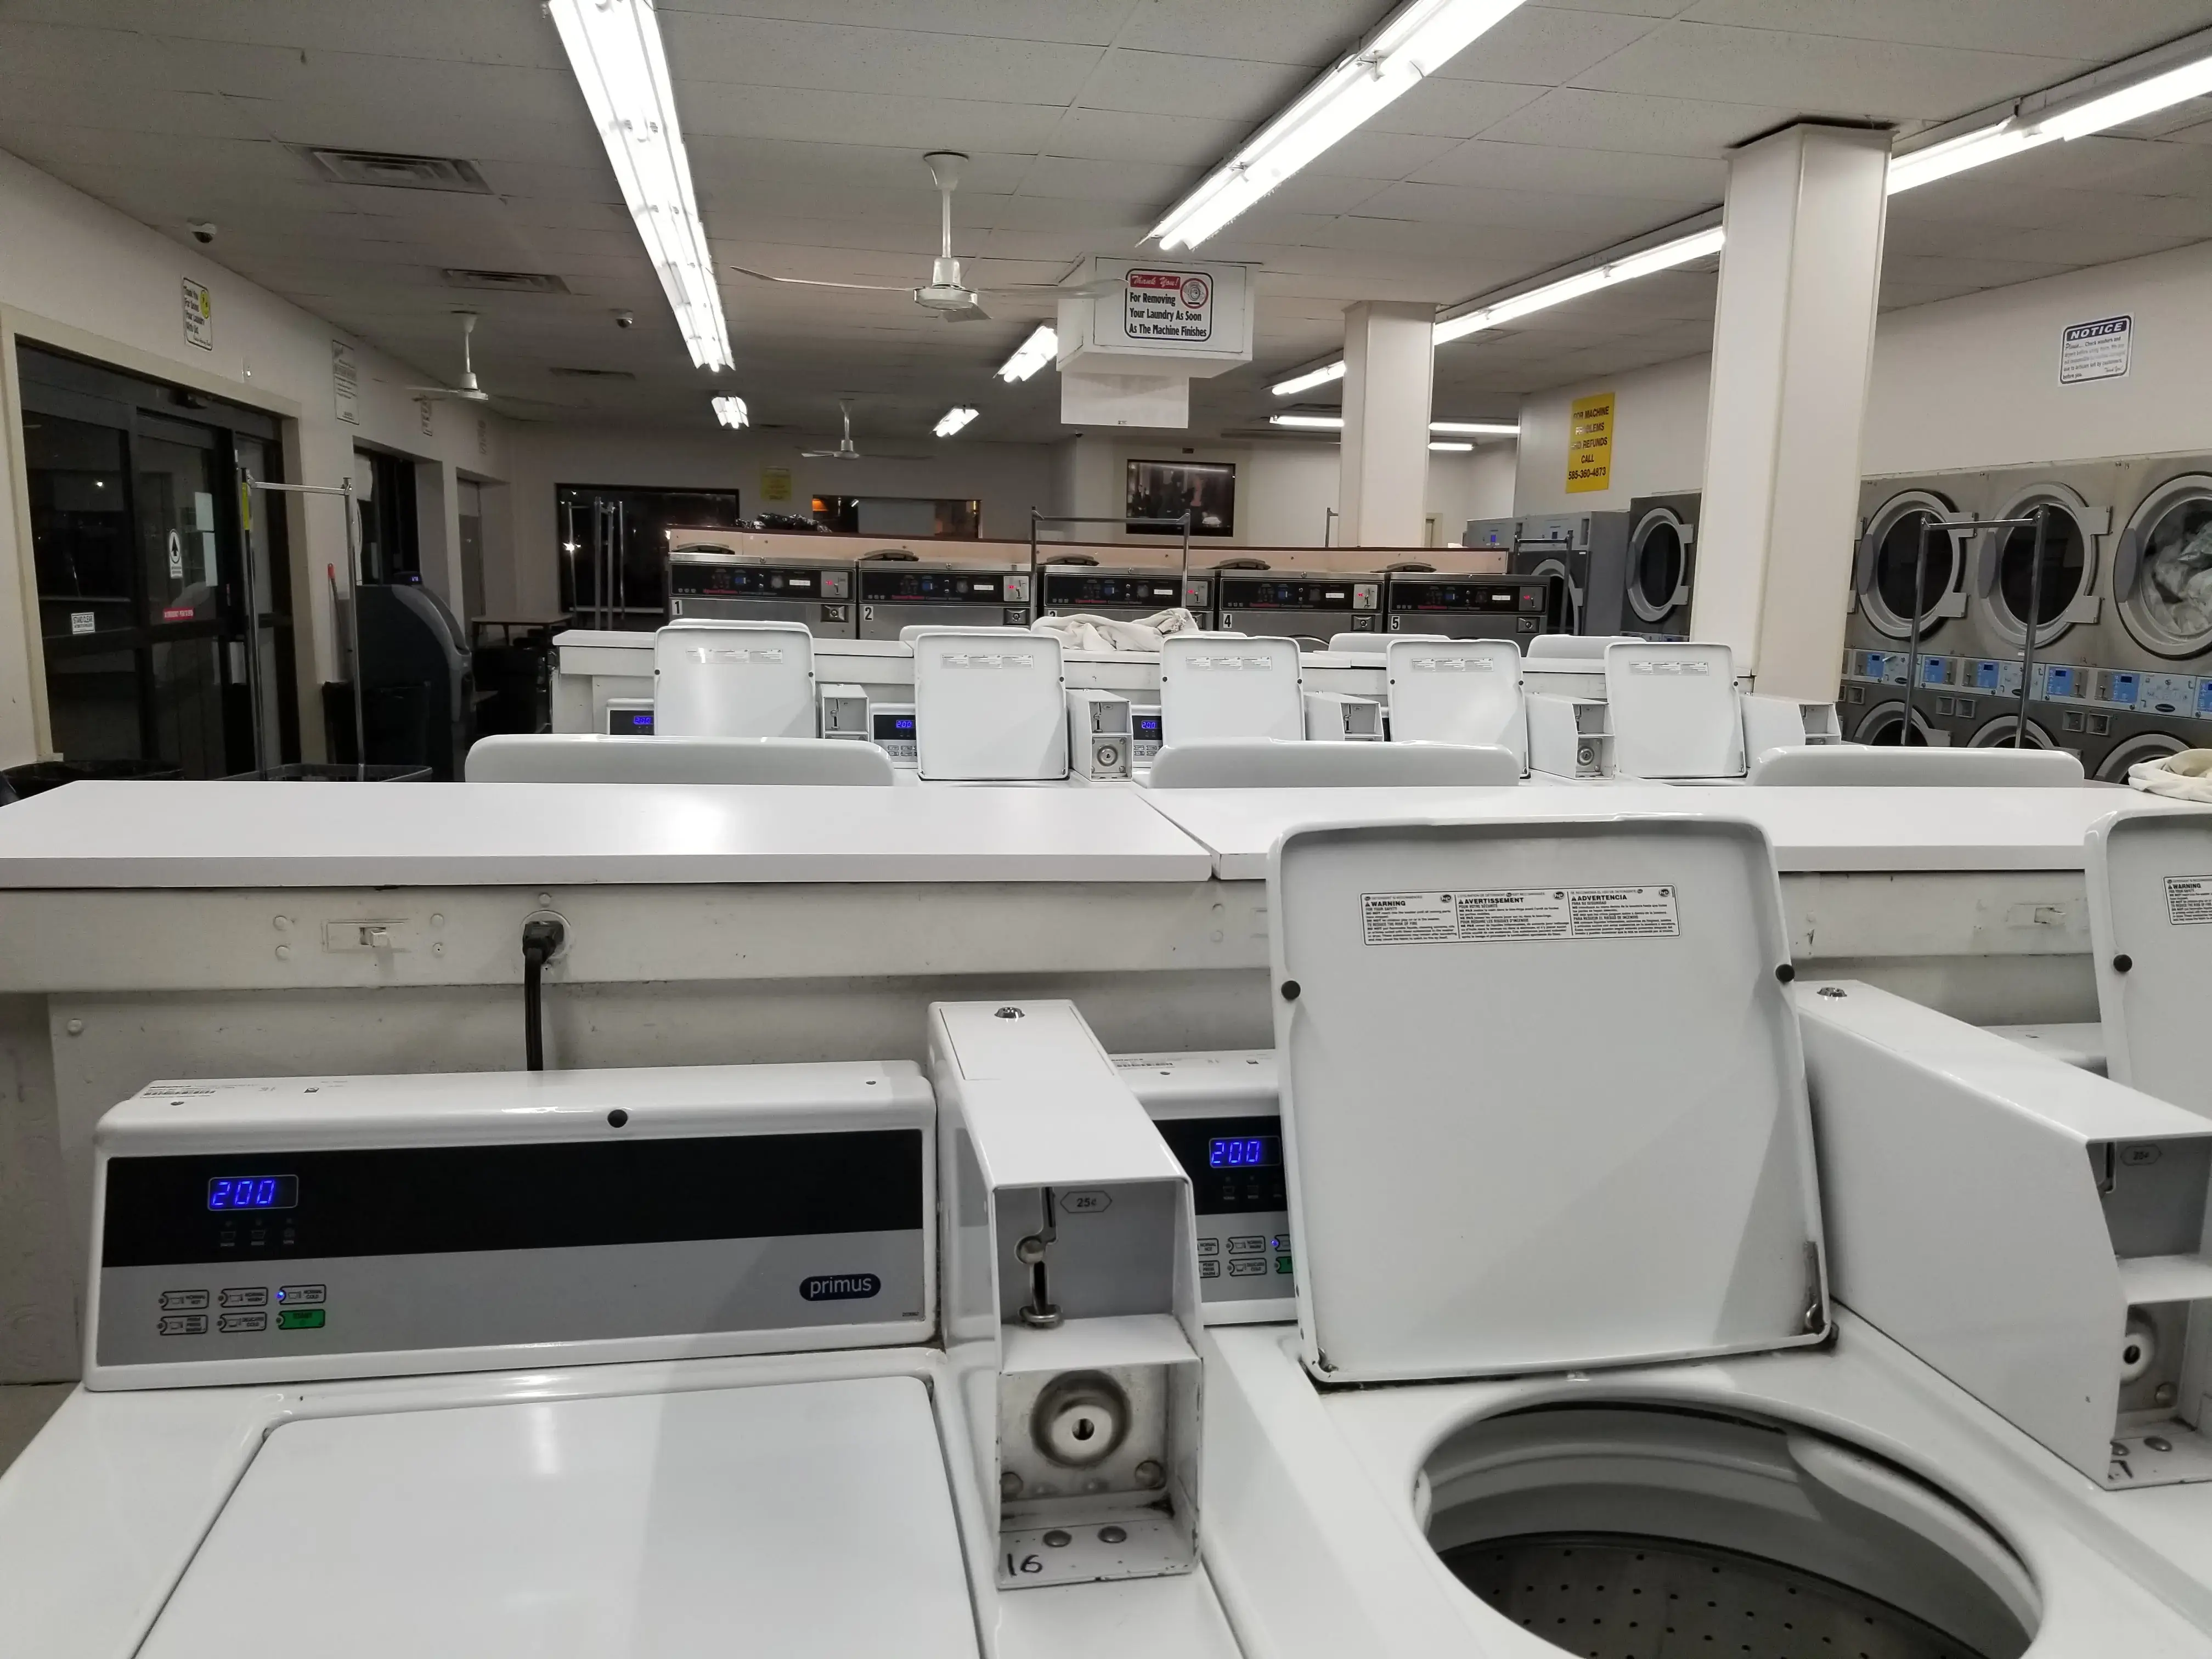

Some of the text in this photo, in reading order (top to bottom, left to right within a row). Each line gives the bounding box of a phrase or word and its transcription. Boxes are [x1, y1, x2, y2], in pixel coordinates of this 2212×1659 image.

[1132, 275, 1179, 287] Thank You!
[1130, 292, 1176, 307] For Removing
[1130, 308, 1201, 321] Your Laundry As Soon
[1129, 324, 1207, 336] As The Machine Finishes
[2070, 322, 2123, 340] NOTICE
[1585, 406, 1610, 419] MACHINE
[1583, 437, 1608, 449] REFUNDS
[1581, 454, 1594, 463] CALL
[674, 601, 680, 614] 1
[865, 607, 872, 620] 2
[1224, 614, 1231, 627] 4
[1392, 617, 1398, 629] 5
[1211, 1141, 1260, 1164] 200
[212, 1180, 275, 1206] 200
[1076, 1198, 1097, 1207] 25¢
[810, 1277, 872, 1298] primus
[1007, 1554, 1042, 1576] 16
